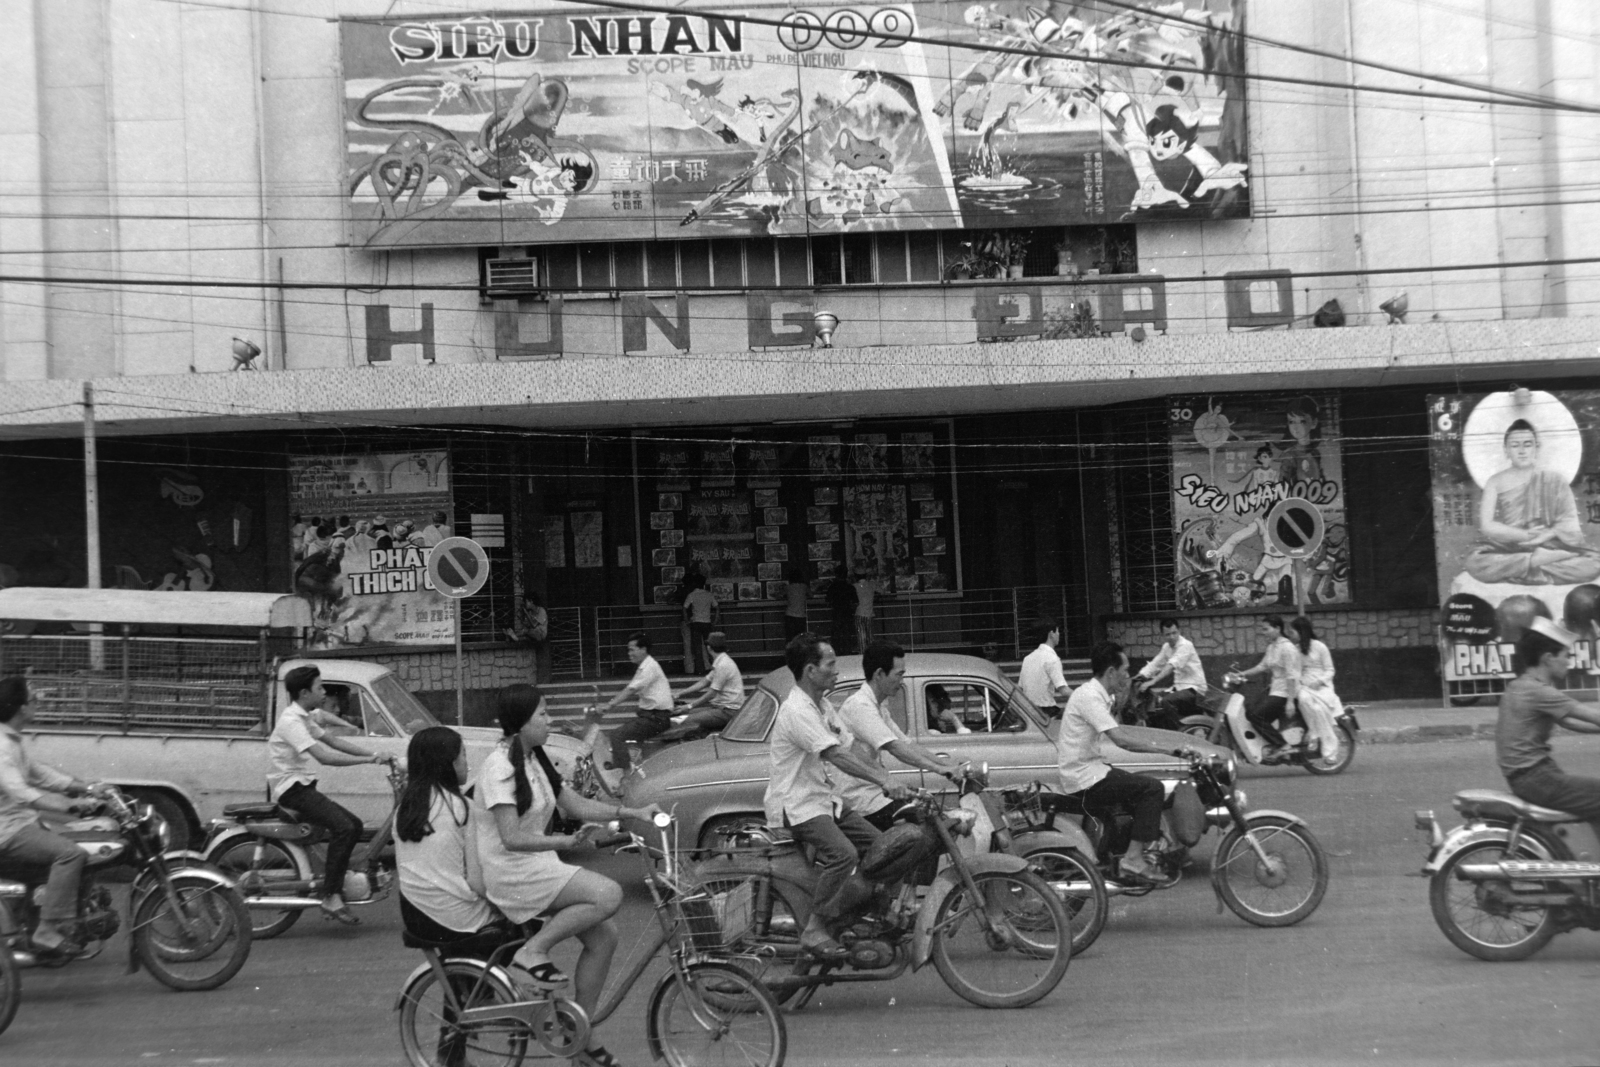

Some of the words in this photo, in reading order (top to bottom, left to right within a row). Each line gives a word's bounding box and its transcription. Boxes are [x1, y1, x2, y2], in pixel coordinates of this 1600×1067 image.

[777, 8, 914, 52] 009
[627, 57, 696, 76] SCOPE
[1170, 408, 1193, 421] 30
[1437, 413, 1452, 431] 6
[1291, 479, 1338, 505] 009
